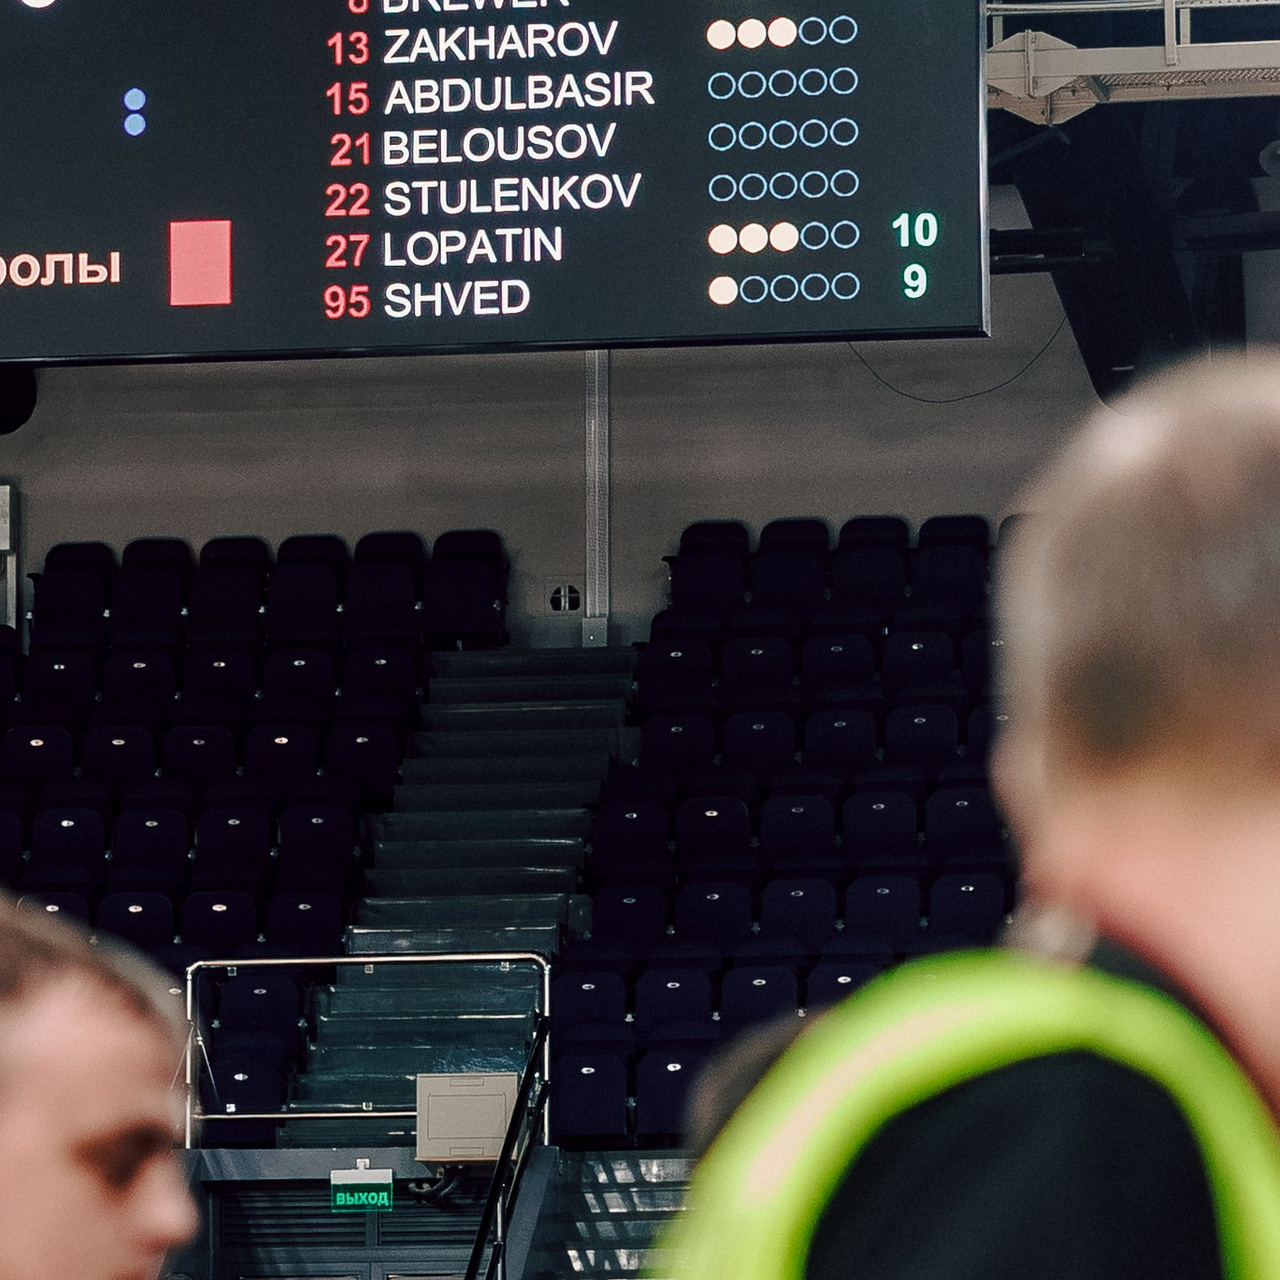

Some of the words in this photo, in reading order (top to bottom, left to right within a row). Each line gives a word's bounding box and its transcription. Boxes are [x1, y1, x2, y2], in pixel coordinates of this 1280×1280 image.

[326, 30, 370, 66] 13
[383, 20, 619, 64] ZAKHAROV
[325, 81, 370, 116] 15
[384, 70, 656, 115] ABDULBASIR
[330, 131, 370, 167] 21
[383, 122, 617, 166] BELOUSOV
[324, 182, 371, 217] 22
[384, 172, 642, 217] STULENKOV
[324, 233, 371, 268] 27
[384, 226, 562, 267] LOPATIN
[892, 212, 938, 248] 10
[323, 284, 371, 320] 95
[384, 279, 531, 318] SHVED
[903, 263, 927, 299] 9
[336, 1192, 389, 1206] ВЫХОД
